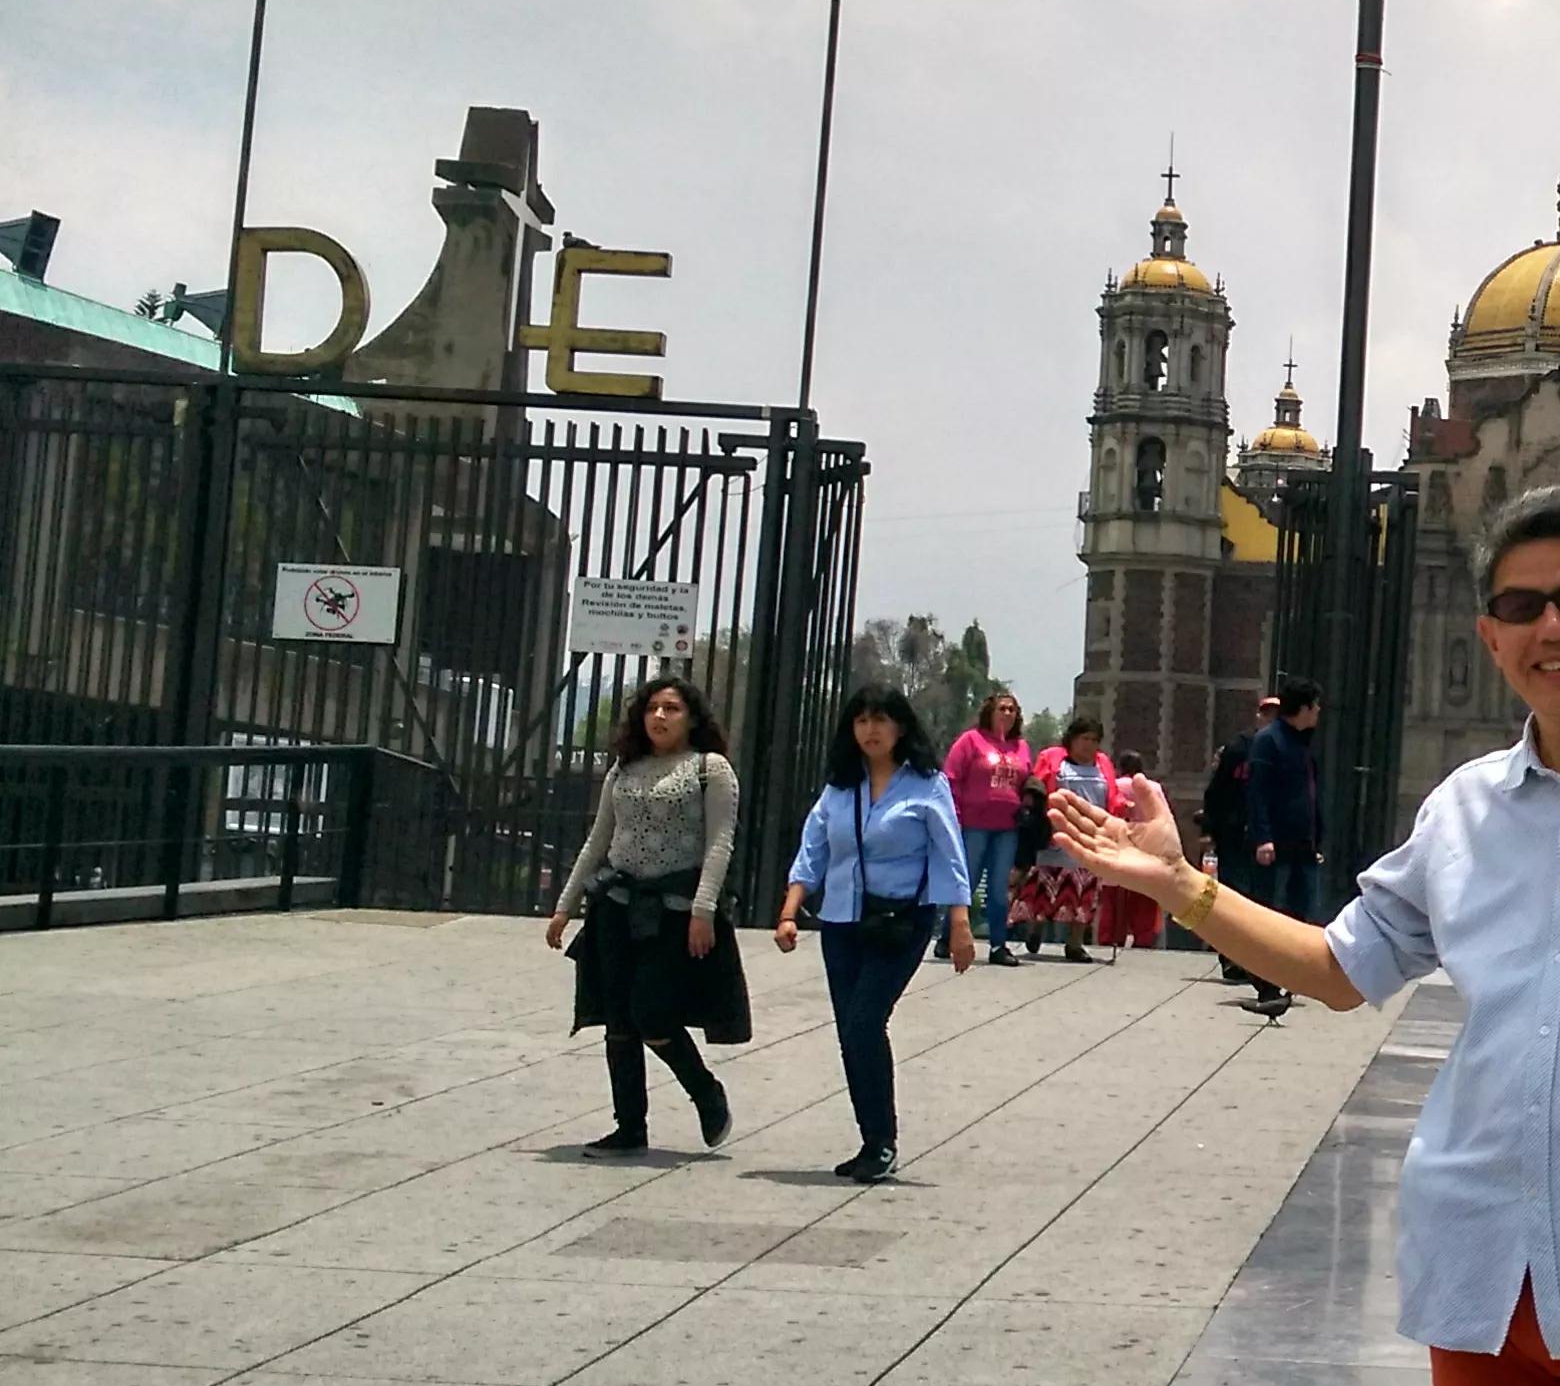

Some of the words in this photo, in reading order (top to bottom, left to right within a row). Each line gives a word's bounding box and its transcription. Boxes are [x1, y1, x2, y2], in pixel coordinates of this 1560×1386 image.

[583, 580, 601, 589] Por
[617, 584, 669, 593] seguridad
[635, 593, 669, 602] demás
[582, 598, 626, 608] Revisión
[629, 601, 641, 609] de
[588, 609, 634, 618] mochilas
[638, 612, 643, 620] y
[647, 612, 679, 620] bultos
